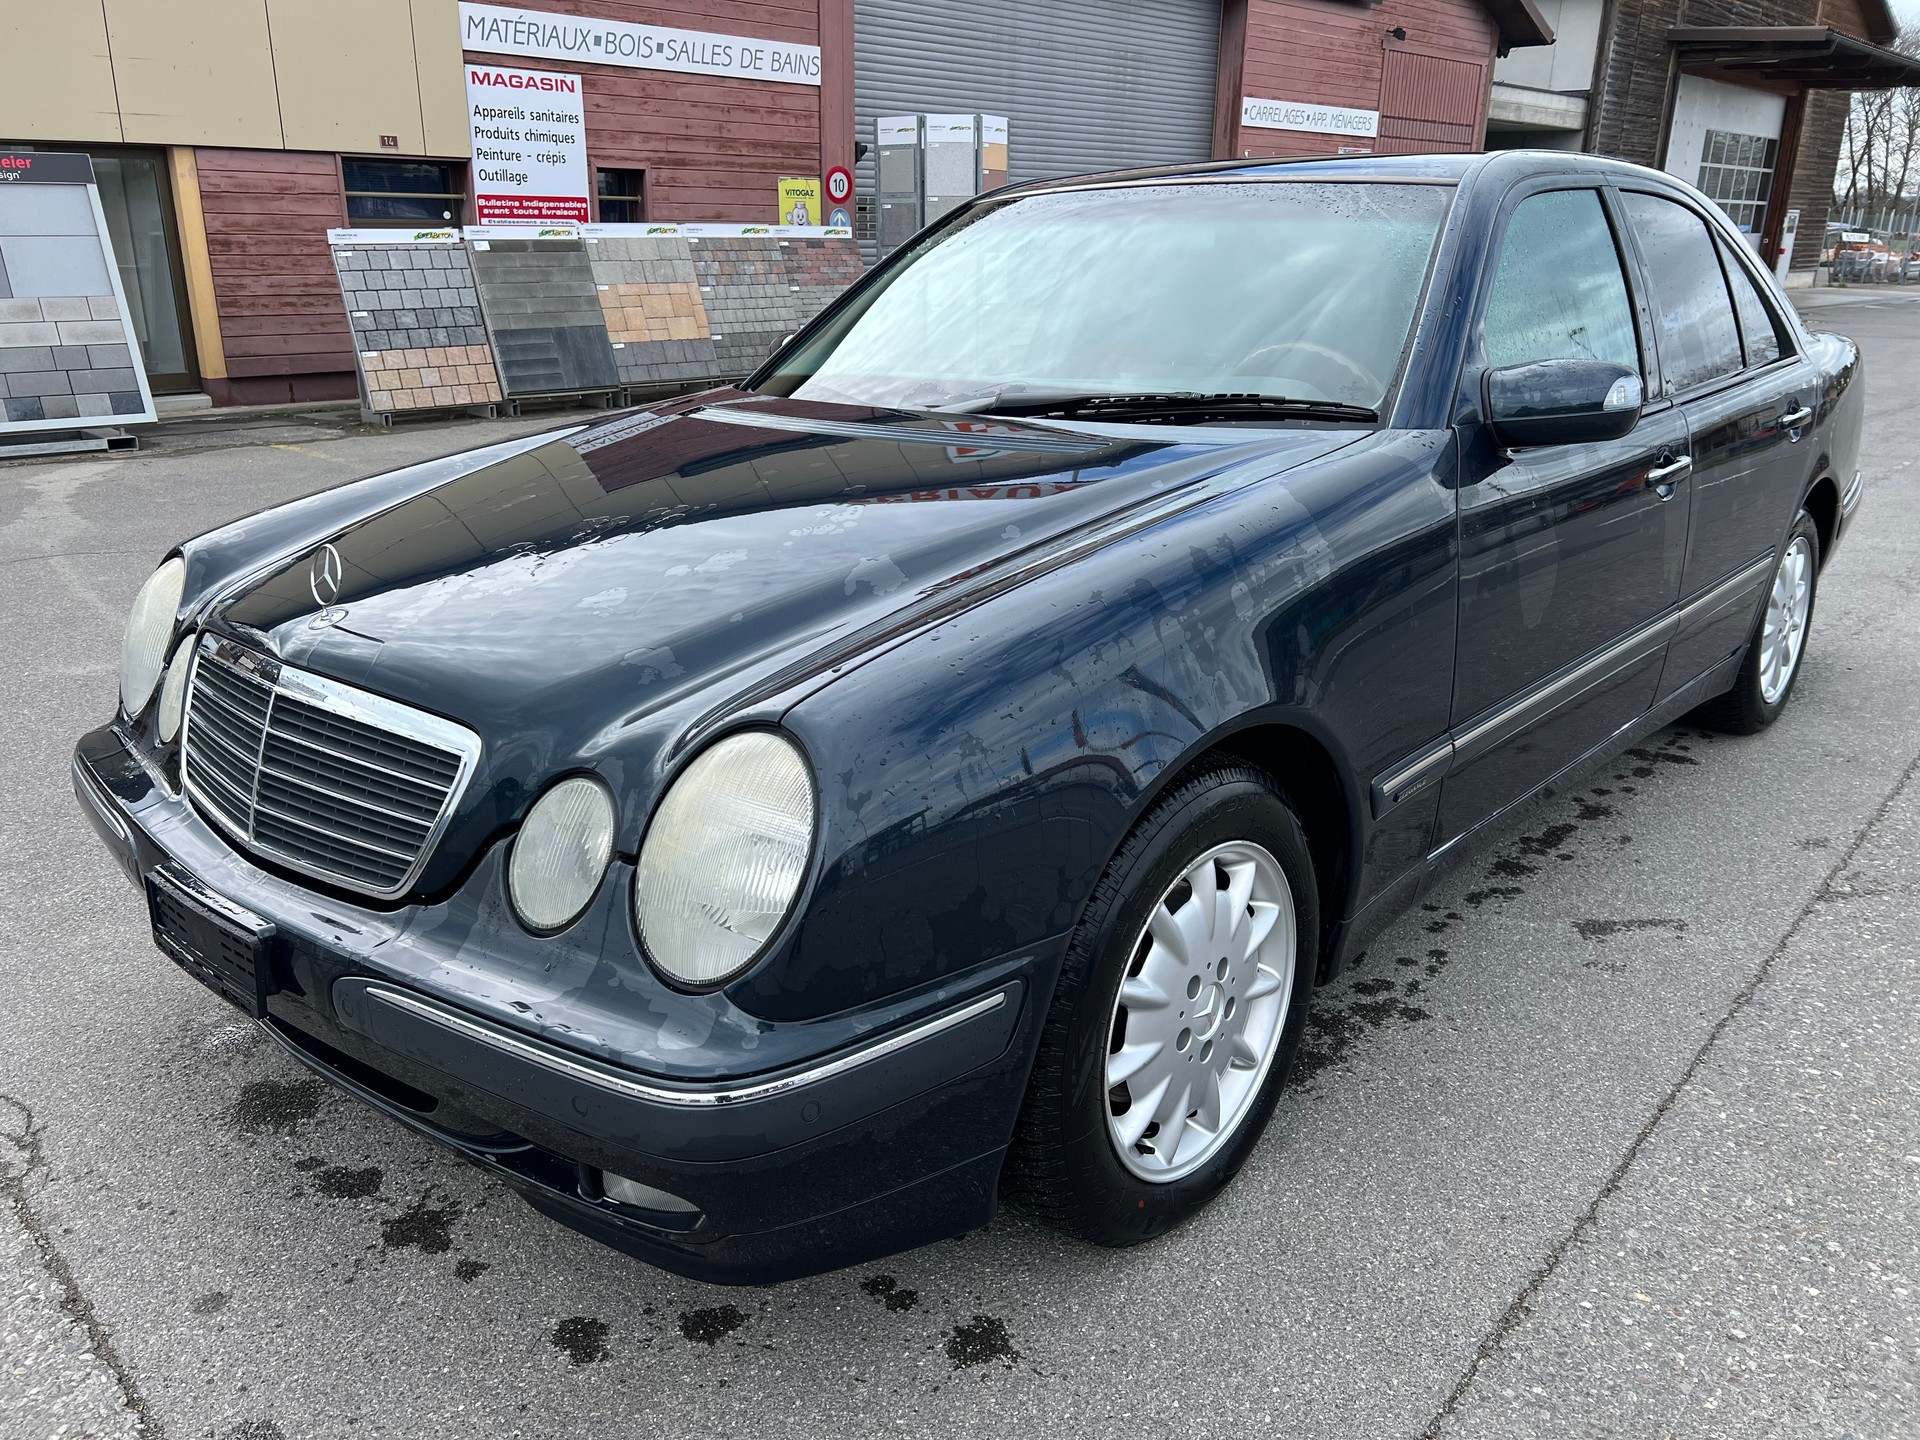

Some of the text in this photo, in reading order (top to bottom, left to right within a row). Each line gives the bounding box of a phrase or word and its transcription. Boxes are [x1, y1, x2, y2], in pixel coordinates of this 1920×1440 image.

[467, 14, 820, 76] MATÉRIAUX BOIS SALLES DE BAINS
[470, 70, 576, 93] MAGASIN
[473, 104, 580, 124] Appareils sanitaires
[1249, 105, 1373, 131] CARRELAGES APP. MÉNAGERS
[384, 136, 394, 146] 14
[474, 125, 576, 146] Produits chimiques
[0, 155, 32, 169] eier
[476, 147, 522, 162] Peinture
[536, 150, 567, 167] crépis
[478, 168, 529, 186] Outillage
[833, 178, 845, 193] 10
[478, 198, 587, 209] Bulletins indispensables
[482, 207, 511, 215] avant
[513, 208, 540, 216] toute
[541, 207, 579, 216] livraison
